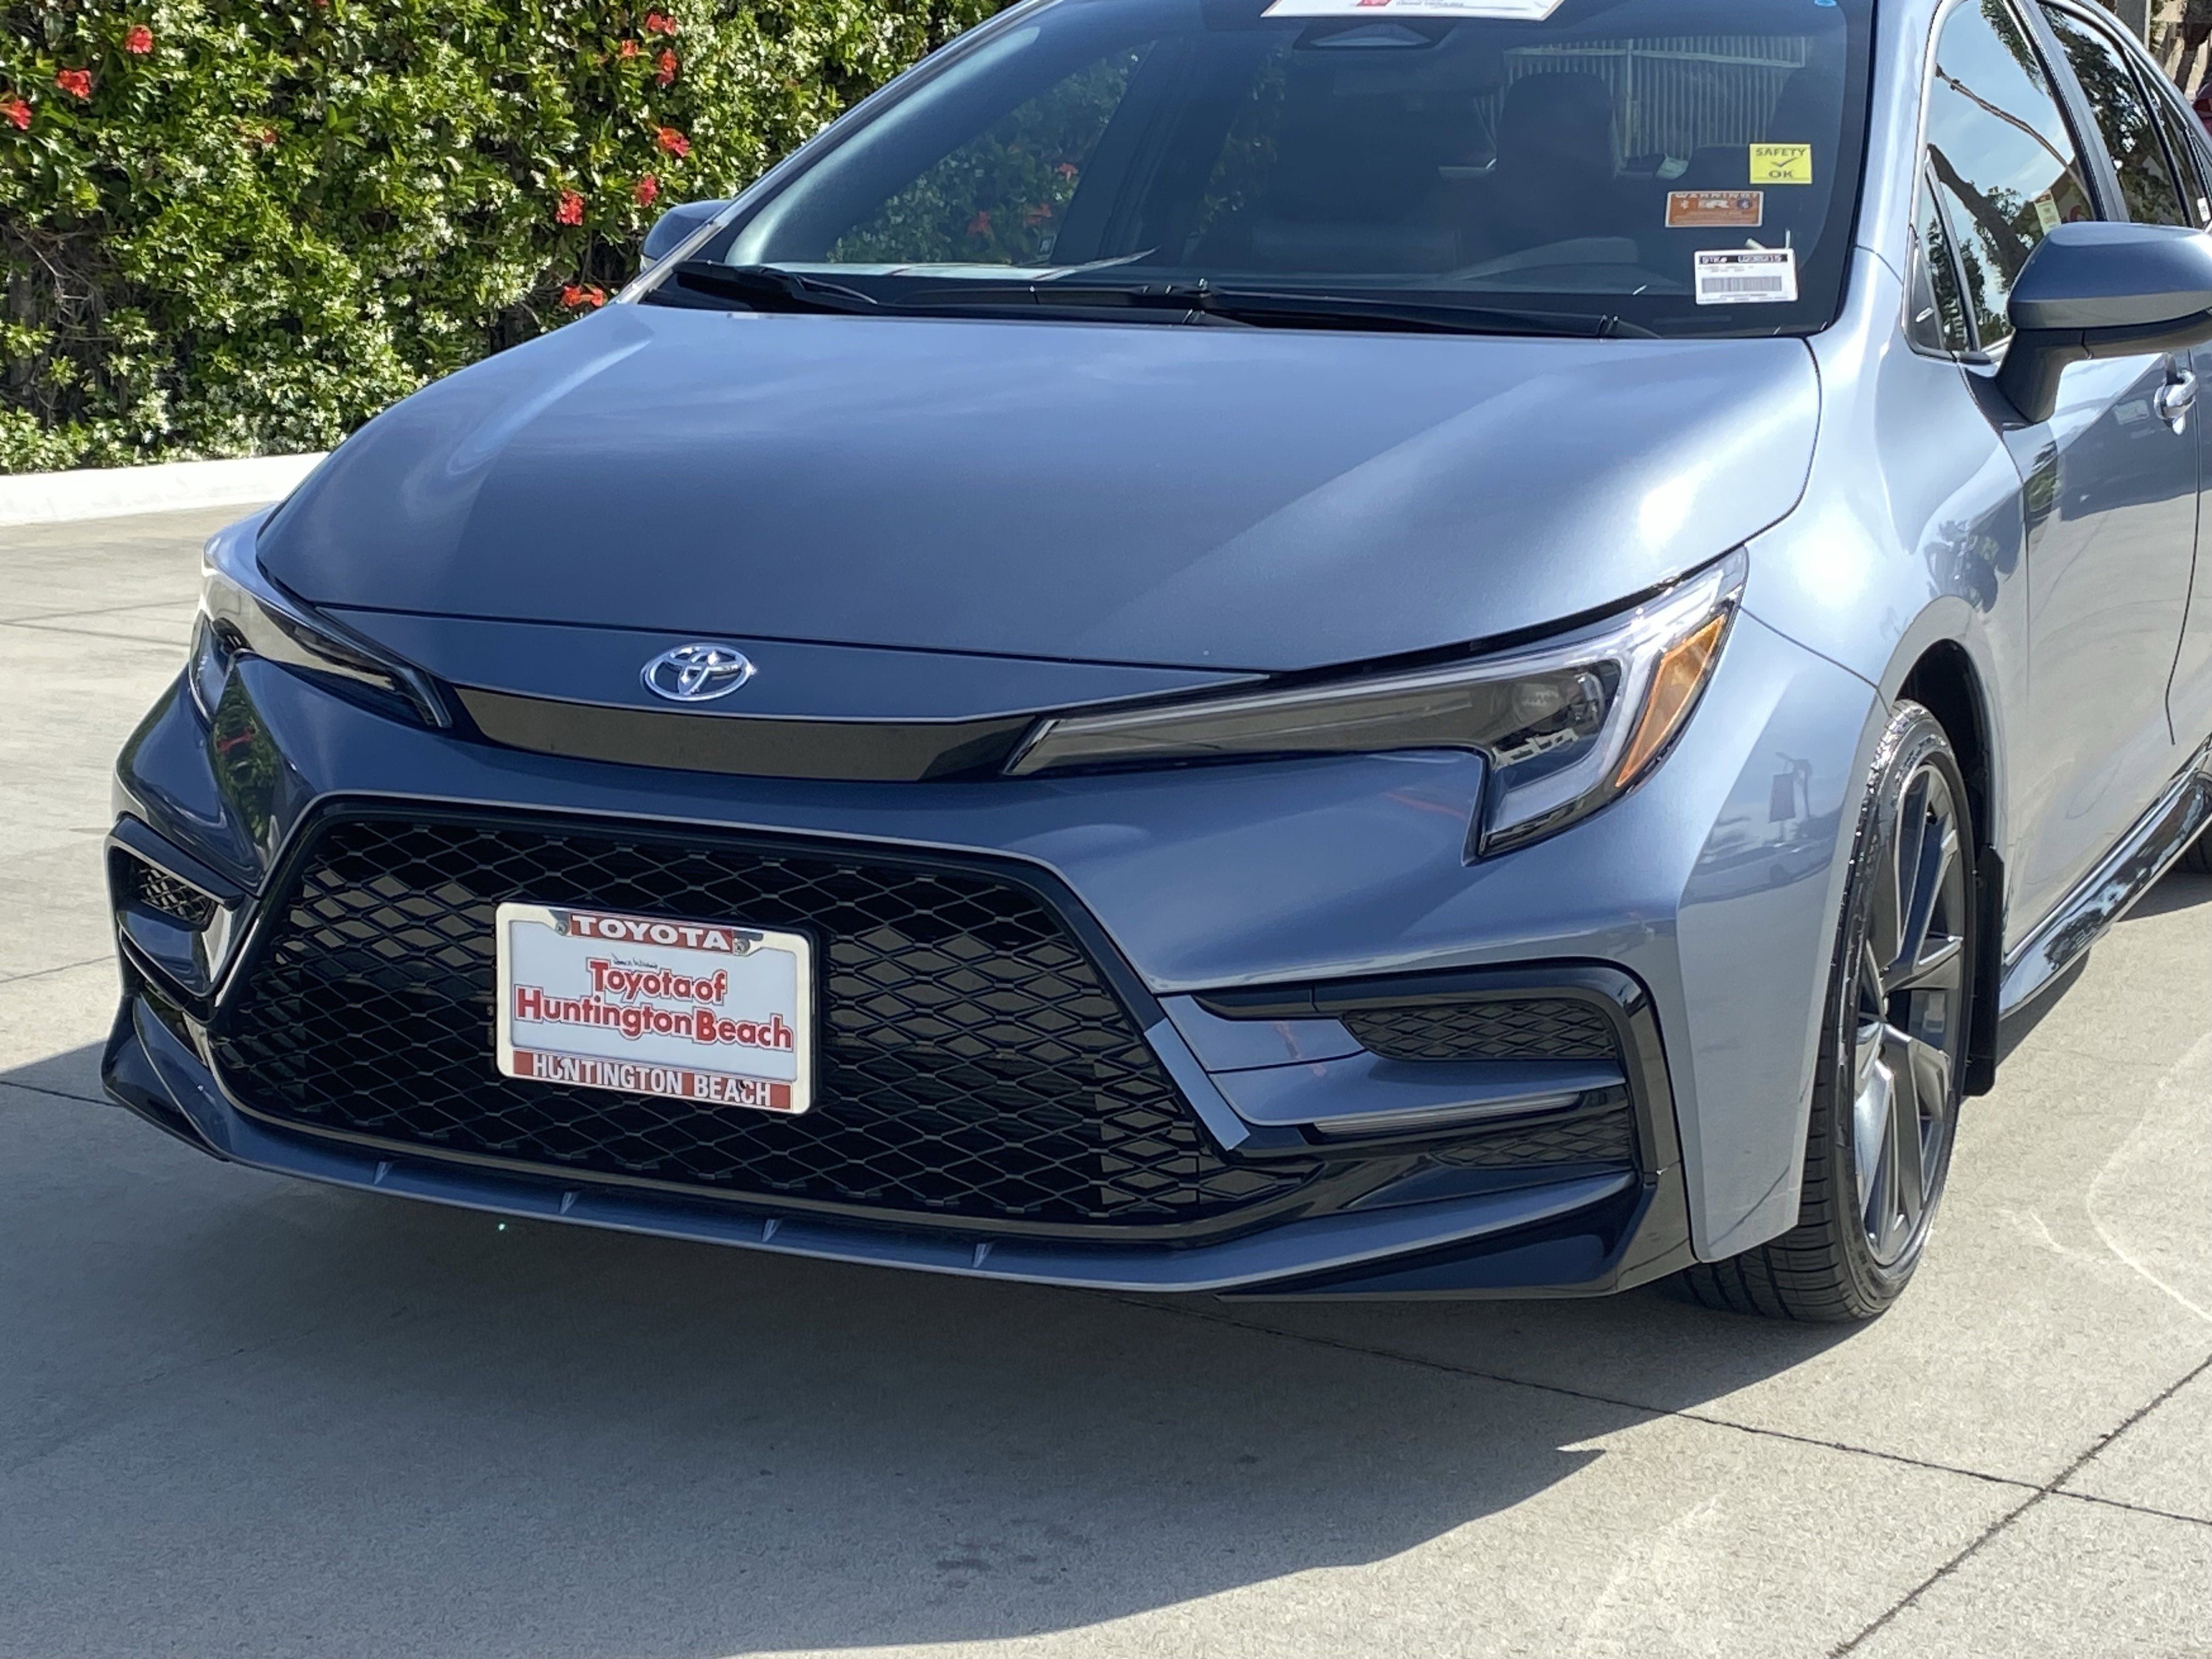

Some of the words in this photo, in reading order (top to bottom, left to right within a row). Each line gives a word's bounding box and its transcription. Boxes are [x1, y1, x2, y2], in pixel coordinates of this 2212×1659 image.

[1756, 148, 1806, 156] SAFETY
[1768, 170, 1793, 178] OK
[572, 915, 731, 950] TOYOTA
[590, 961, 691, 1000] Toyota
[694, 972, 726, 1002] of
[516, 988, 692, 1036] Huntington
[695, 1011, 792, 1048] Beach
[532, 1053, 682, 1095] HUNTINGTON
[693, 1074, 771, 1107] BEACH
